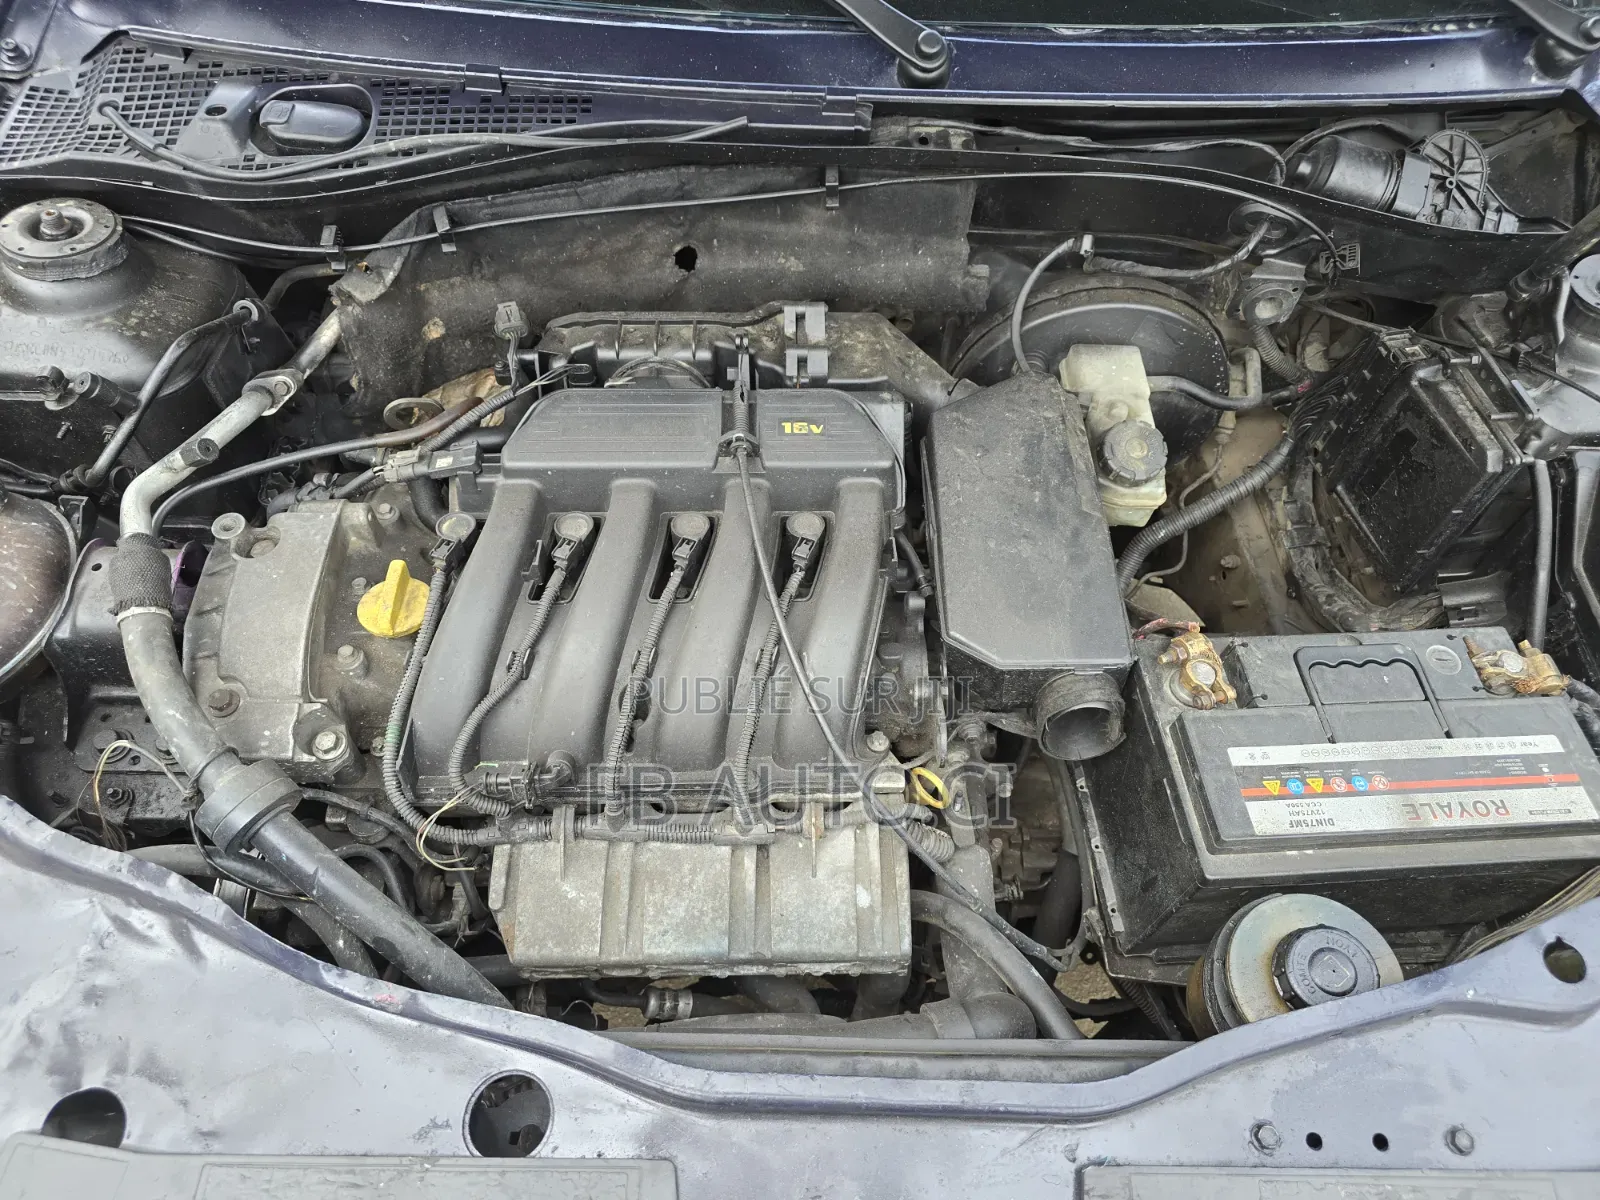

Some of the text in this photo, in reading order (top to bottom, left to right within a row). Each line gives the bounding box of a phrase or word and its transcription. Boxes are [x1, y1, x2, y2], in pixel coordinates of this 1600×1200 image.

[1520, 741, 1539, 749] Year
[1288, 808, 1326, 817] 12V75AH
[1400, 798, 1511, 822] ROYALE
[1288, 817, 1335, 829] DIN75MF
